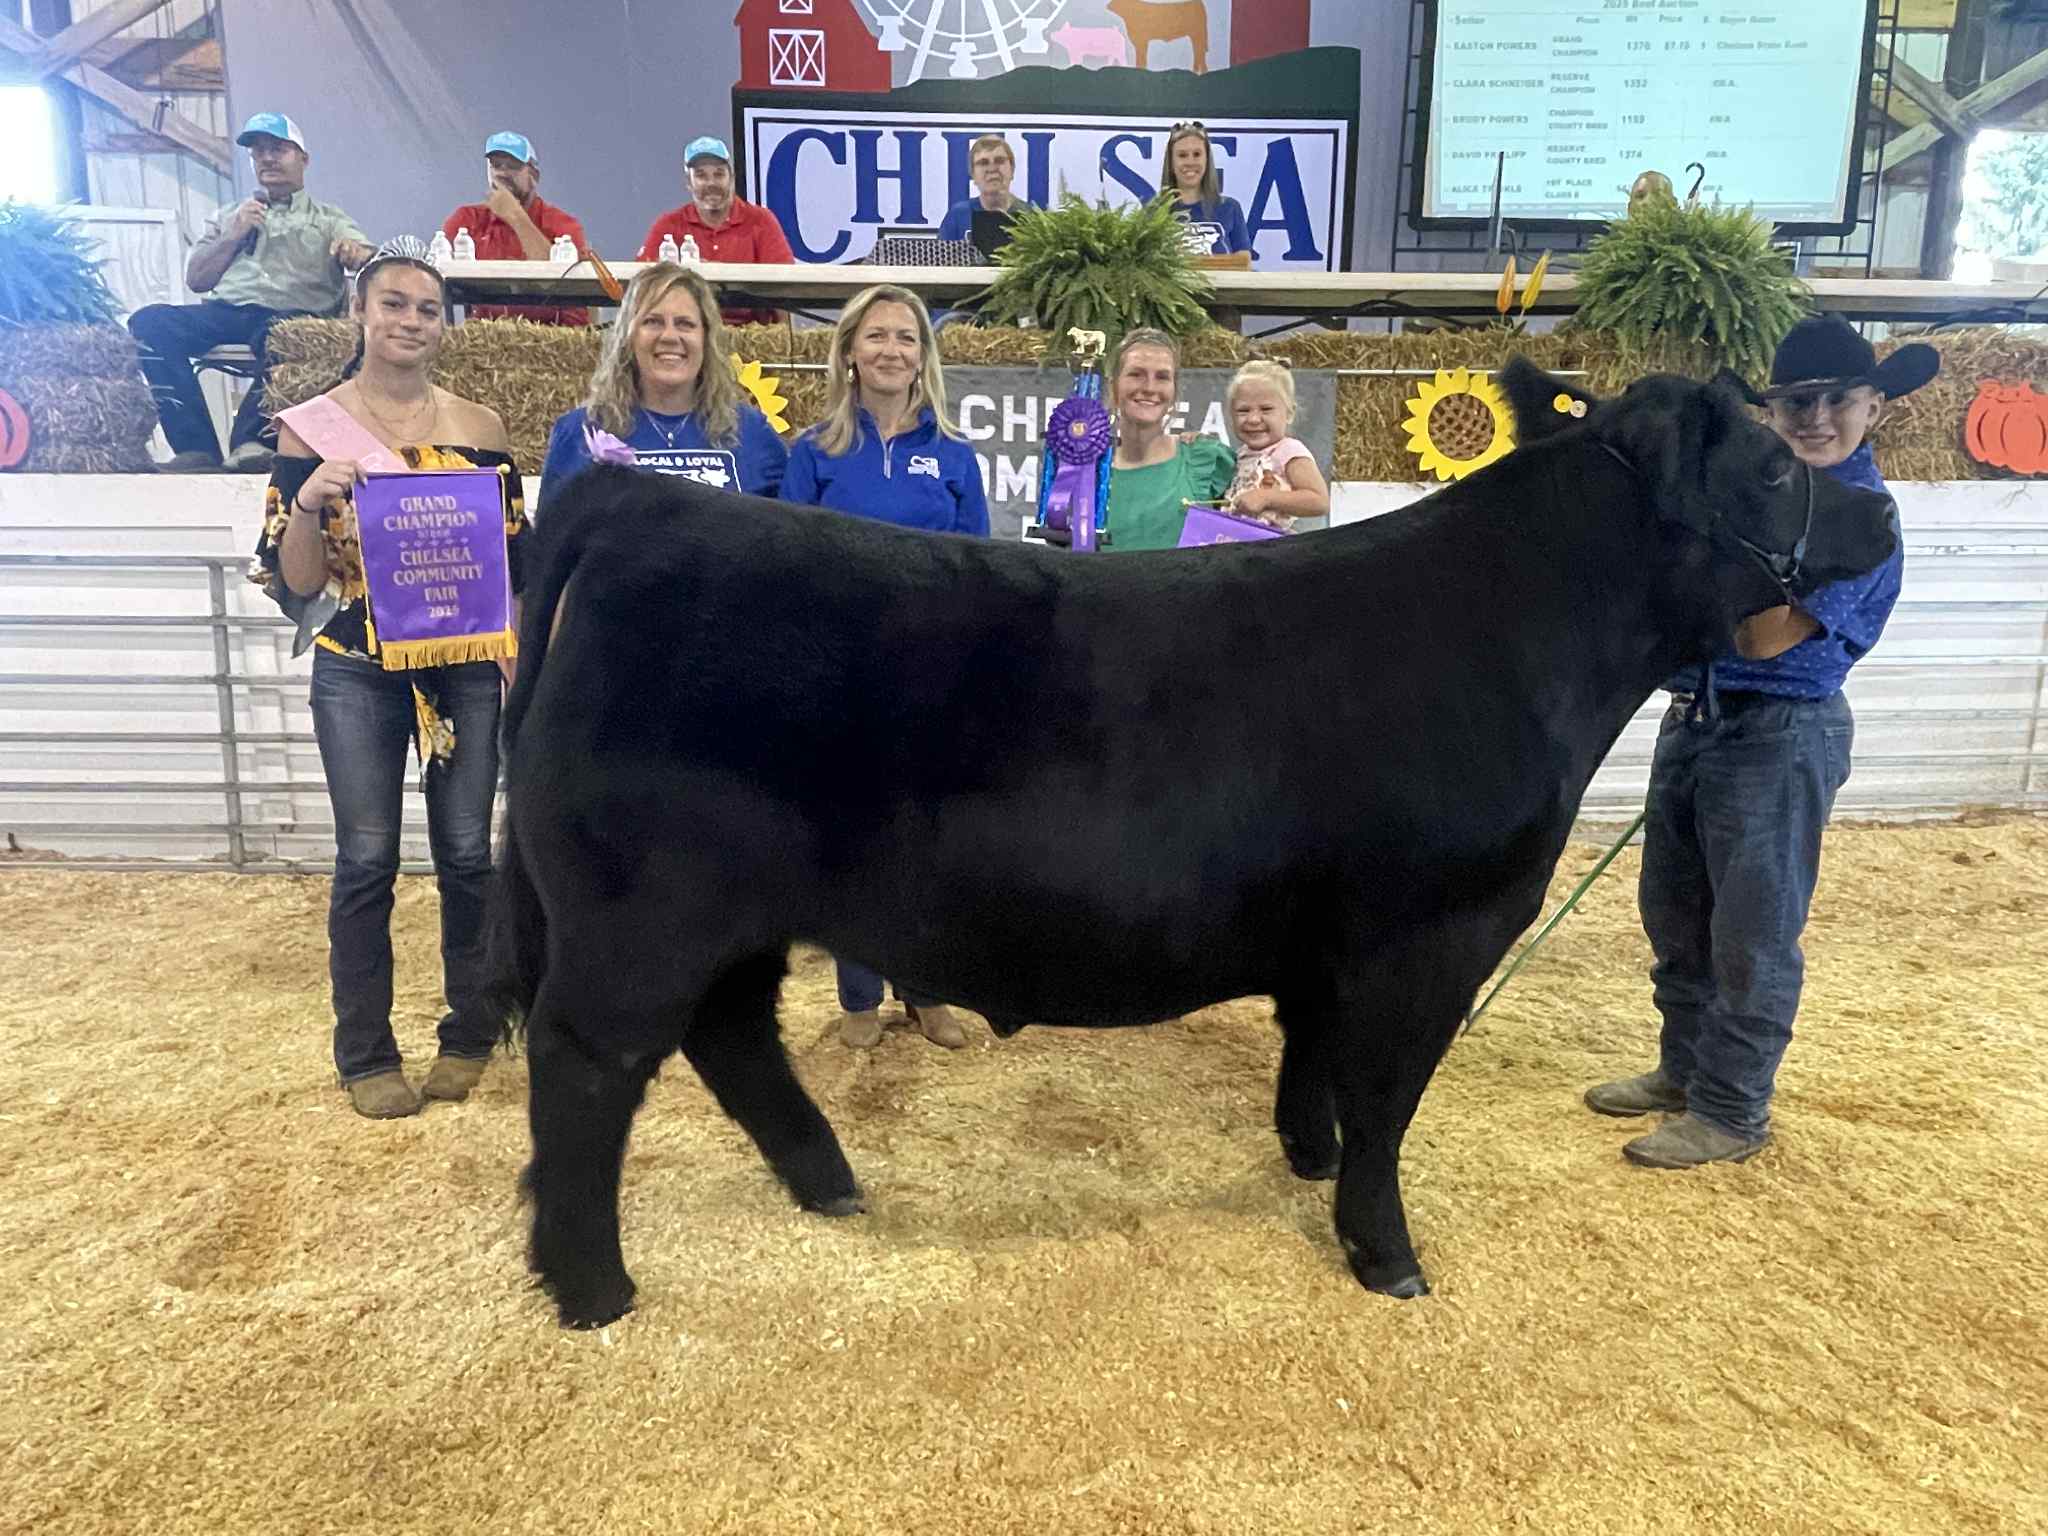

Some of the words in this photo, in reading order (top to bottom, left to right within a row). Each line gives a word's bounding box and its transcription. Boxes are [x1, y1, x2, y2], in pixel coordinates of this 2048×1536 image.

[1453, 42, 1494, 50] EASTON
[1497, 42, 1537, 50] POWERS
[1551, 73, 1590, 81] RESERVE
[1453, 79, 1486, 88] CLARA
[1489, 115, 1529, 124] POWERS
[1452, 151, 1482, 159] DAVID
[1546, 157, 1581, 165] COUNTY
[1452, 185, 1478, 193] ALICE
[766, 128, 1324, 264] CHLSA
[959, 394, 1231, 448] CHEA
[634, 456, 674, 467] LOCAL
[686, 456, 725, 467] LOYAL
[400, 495, 457, 513] GRAND
[383, 511, 479, 532] CHAMPION
[401, 546, 473, 566] CHELSEA
[393, 564, 484, 586] COMMUNITY
[424, 585, 460, 602] FAIR
